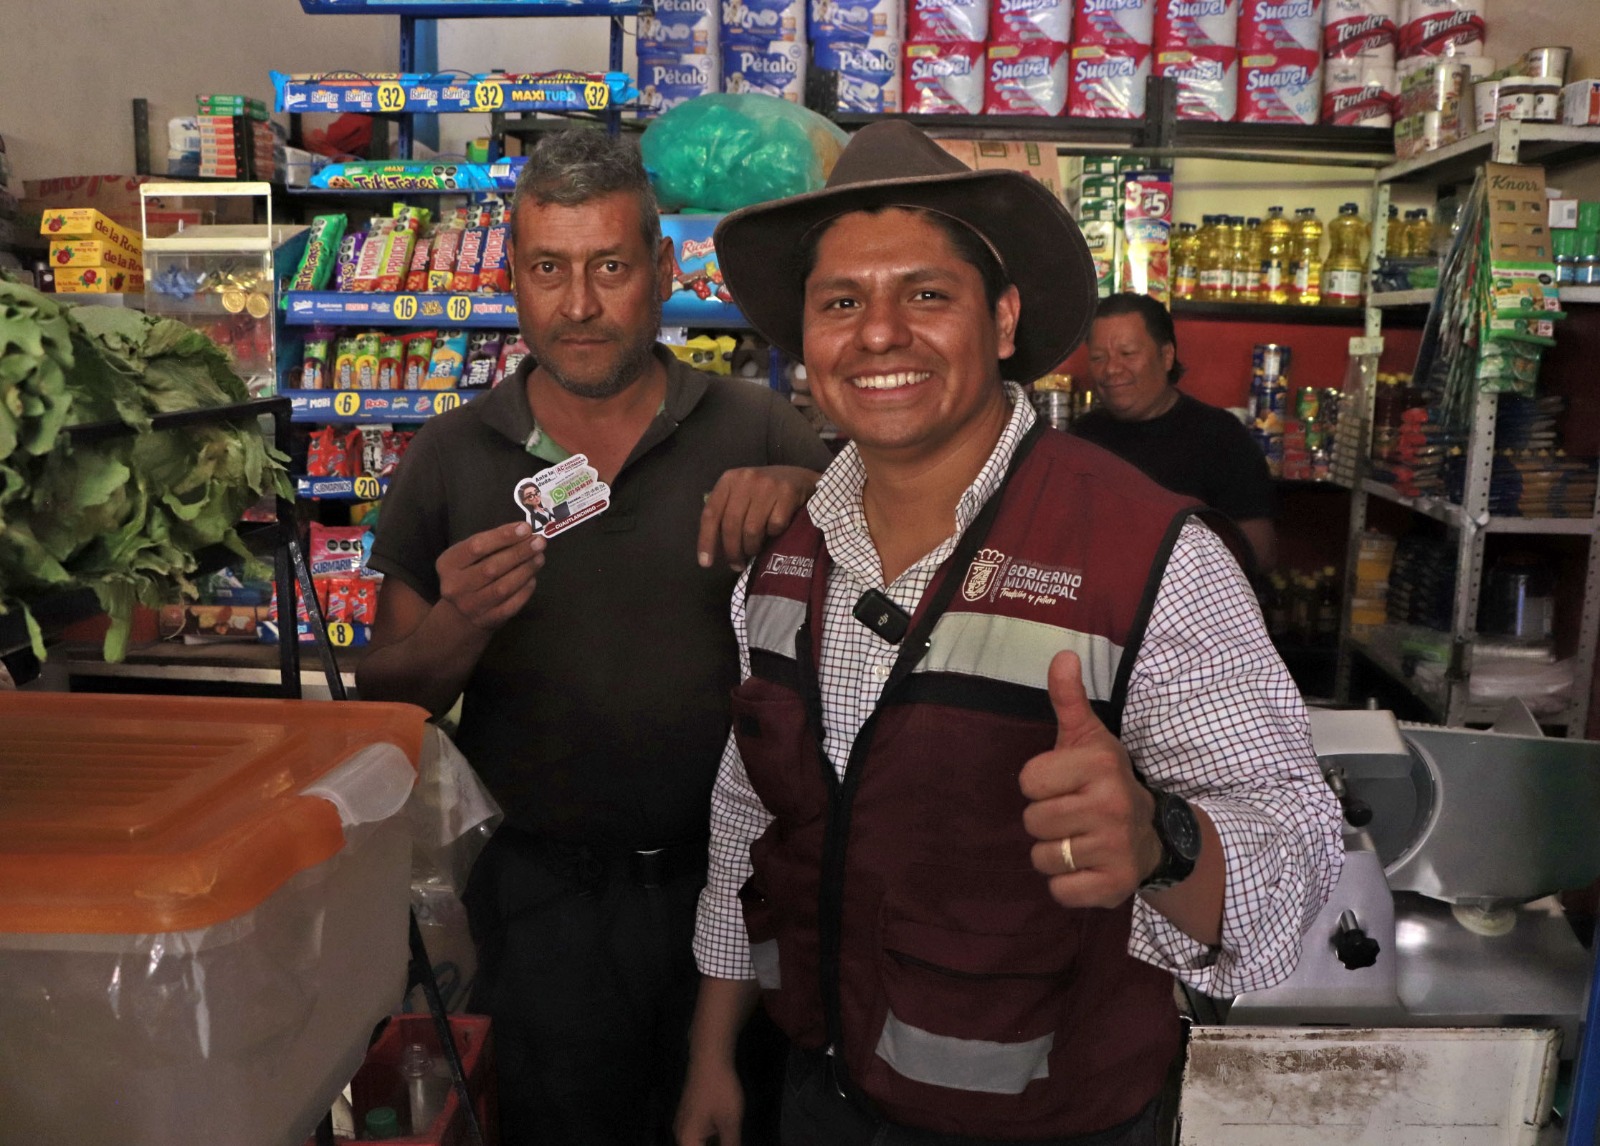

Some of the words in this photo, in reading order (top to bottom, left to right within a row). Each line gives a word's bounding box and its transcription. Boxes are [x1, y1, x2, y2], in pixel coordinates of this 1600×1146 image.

[1166, 0, 1226, 19] Suavel
[1253, 1, 1314, 21] Suavel
[1336, 14, 1388, 42] Tender
[1421, 10, 1477, 39] Tender
[741, 52, 797, 73] Pétalo
[838, 51, 895, 70] Pétalo
[910, 55, 970, 80] Suavel
[991, 57, 1050, 81] Suavel
[1074, 58, 1136, 82] Suavel
[653, 66, 707, 85] Pétalo
[1246, 66, 1307, 90] Suavel
[311, 91, 338, 103] Barritas
[345, 91, 373, 103] Barritas
[410, 88, 438, 100] Barritas
[442, 87, 470, 100] Barritas
[1332, 84, 1385, 112] Tender
[1493, 175, 1539, 192] Knorr
[95, 220, 109, 235] de
[109, 227, 119, 243] la
[104, 250, 118, 264] de
[118, 254, 127, 268] la
[555, 505, 597, 529] CUAUTLANCINGO
[1008, 564, 1082, 588] GOBIERNO
[1003, 577, 1078, 600] MUNICIPAL
